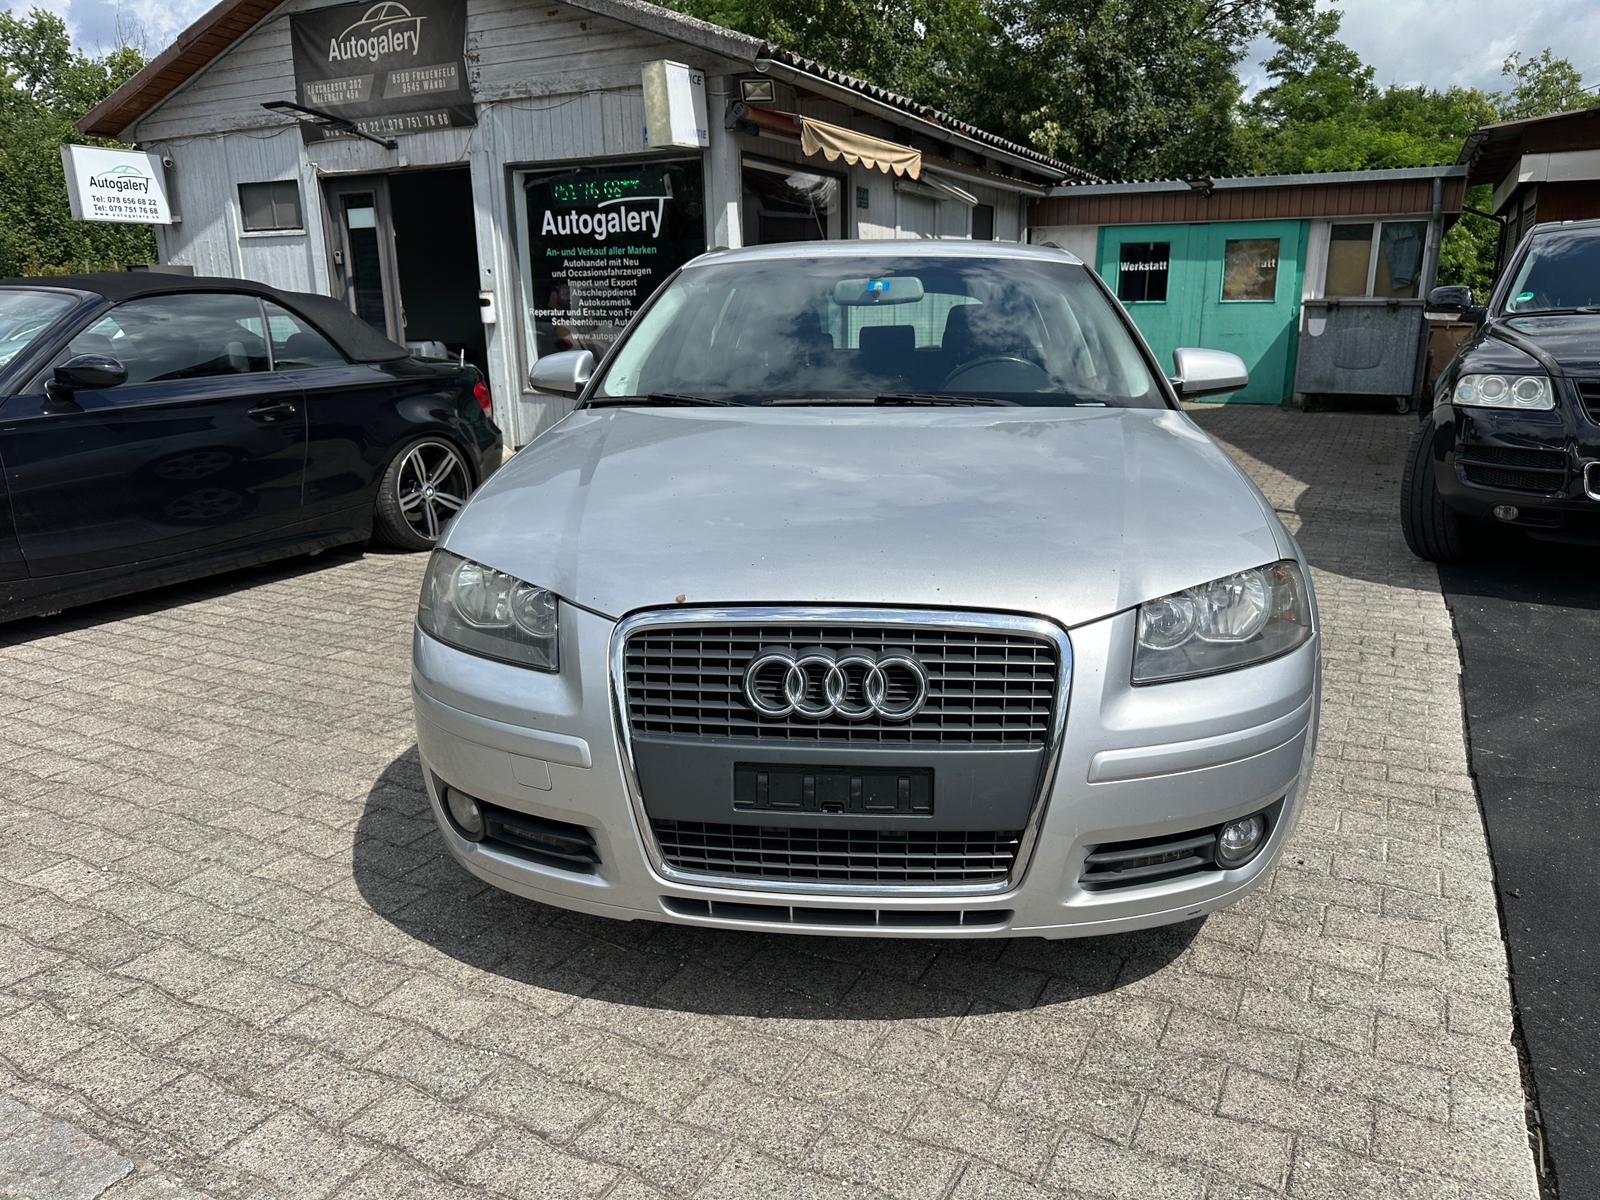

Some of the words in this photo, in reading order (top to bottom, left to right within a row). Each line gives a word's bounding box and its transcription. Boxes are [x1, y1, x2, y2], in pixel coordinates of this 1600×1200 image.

[329, 22, 420, 62] Autogalery
[402, 82, 420, 93] 9545
[370, 120, 380, 132] 22
[407, 116, 422, 128] 751
[424, 114, 436, 126] 76
[438, 113, 449, 125] 68
[90, 175, 149, 194] Autogalery
[92, 195, 105, 203] Tel:
[123, 197, 136, 205] 656
[93, 204, 107, 212] Tel:
[150, 207, 158, 215] 68
[541, 200, 665, 241] Autogalery
[546, 248, 560, 256] An-
[561, 247, 576, 256] und
[578, 247, 607, 256] Verkauf
[608, 246, 626, 255] aller
[627, 245, 657, 255] Marken
[563, 259, 607, 267] Autohandel
[608, 258, 621, 266] mit
[623, 258, 639, 266] Neu
[1120, 261, 1167, 272] Werkstatt
[552, 269, 567, 278] und
[568, 267, 652, 277] Occasionsfahrzeugen
[567, 279, 593, 288] Import
[594, 278, 609, 287] und
[611, 278, 637, 288] Export
[572, 288, 637, 298] Abschleppdienst
[578, 298, 632, 307] Autokosmetik
[529, 308, 565, 318] Reperatur
[566, 307, 581, 316] und
[582, 308, 607, 316] Ersatz
[624, 308, 638, 316] Fro
[552, 317, 613, 328] Scheibentönung
